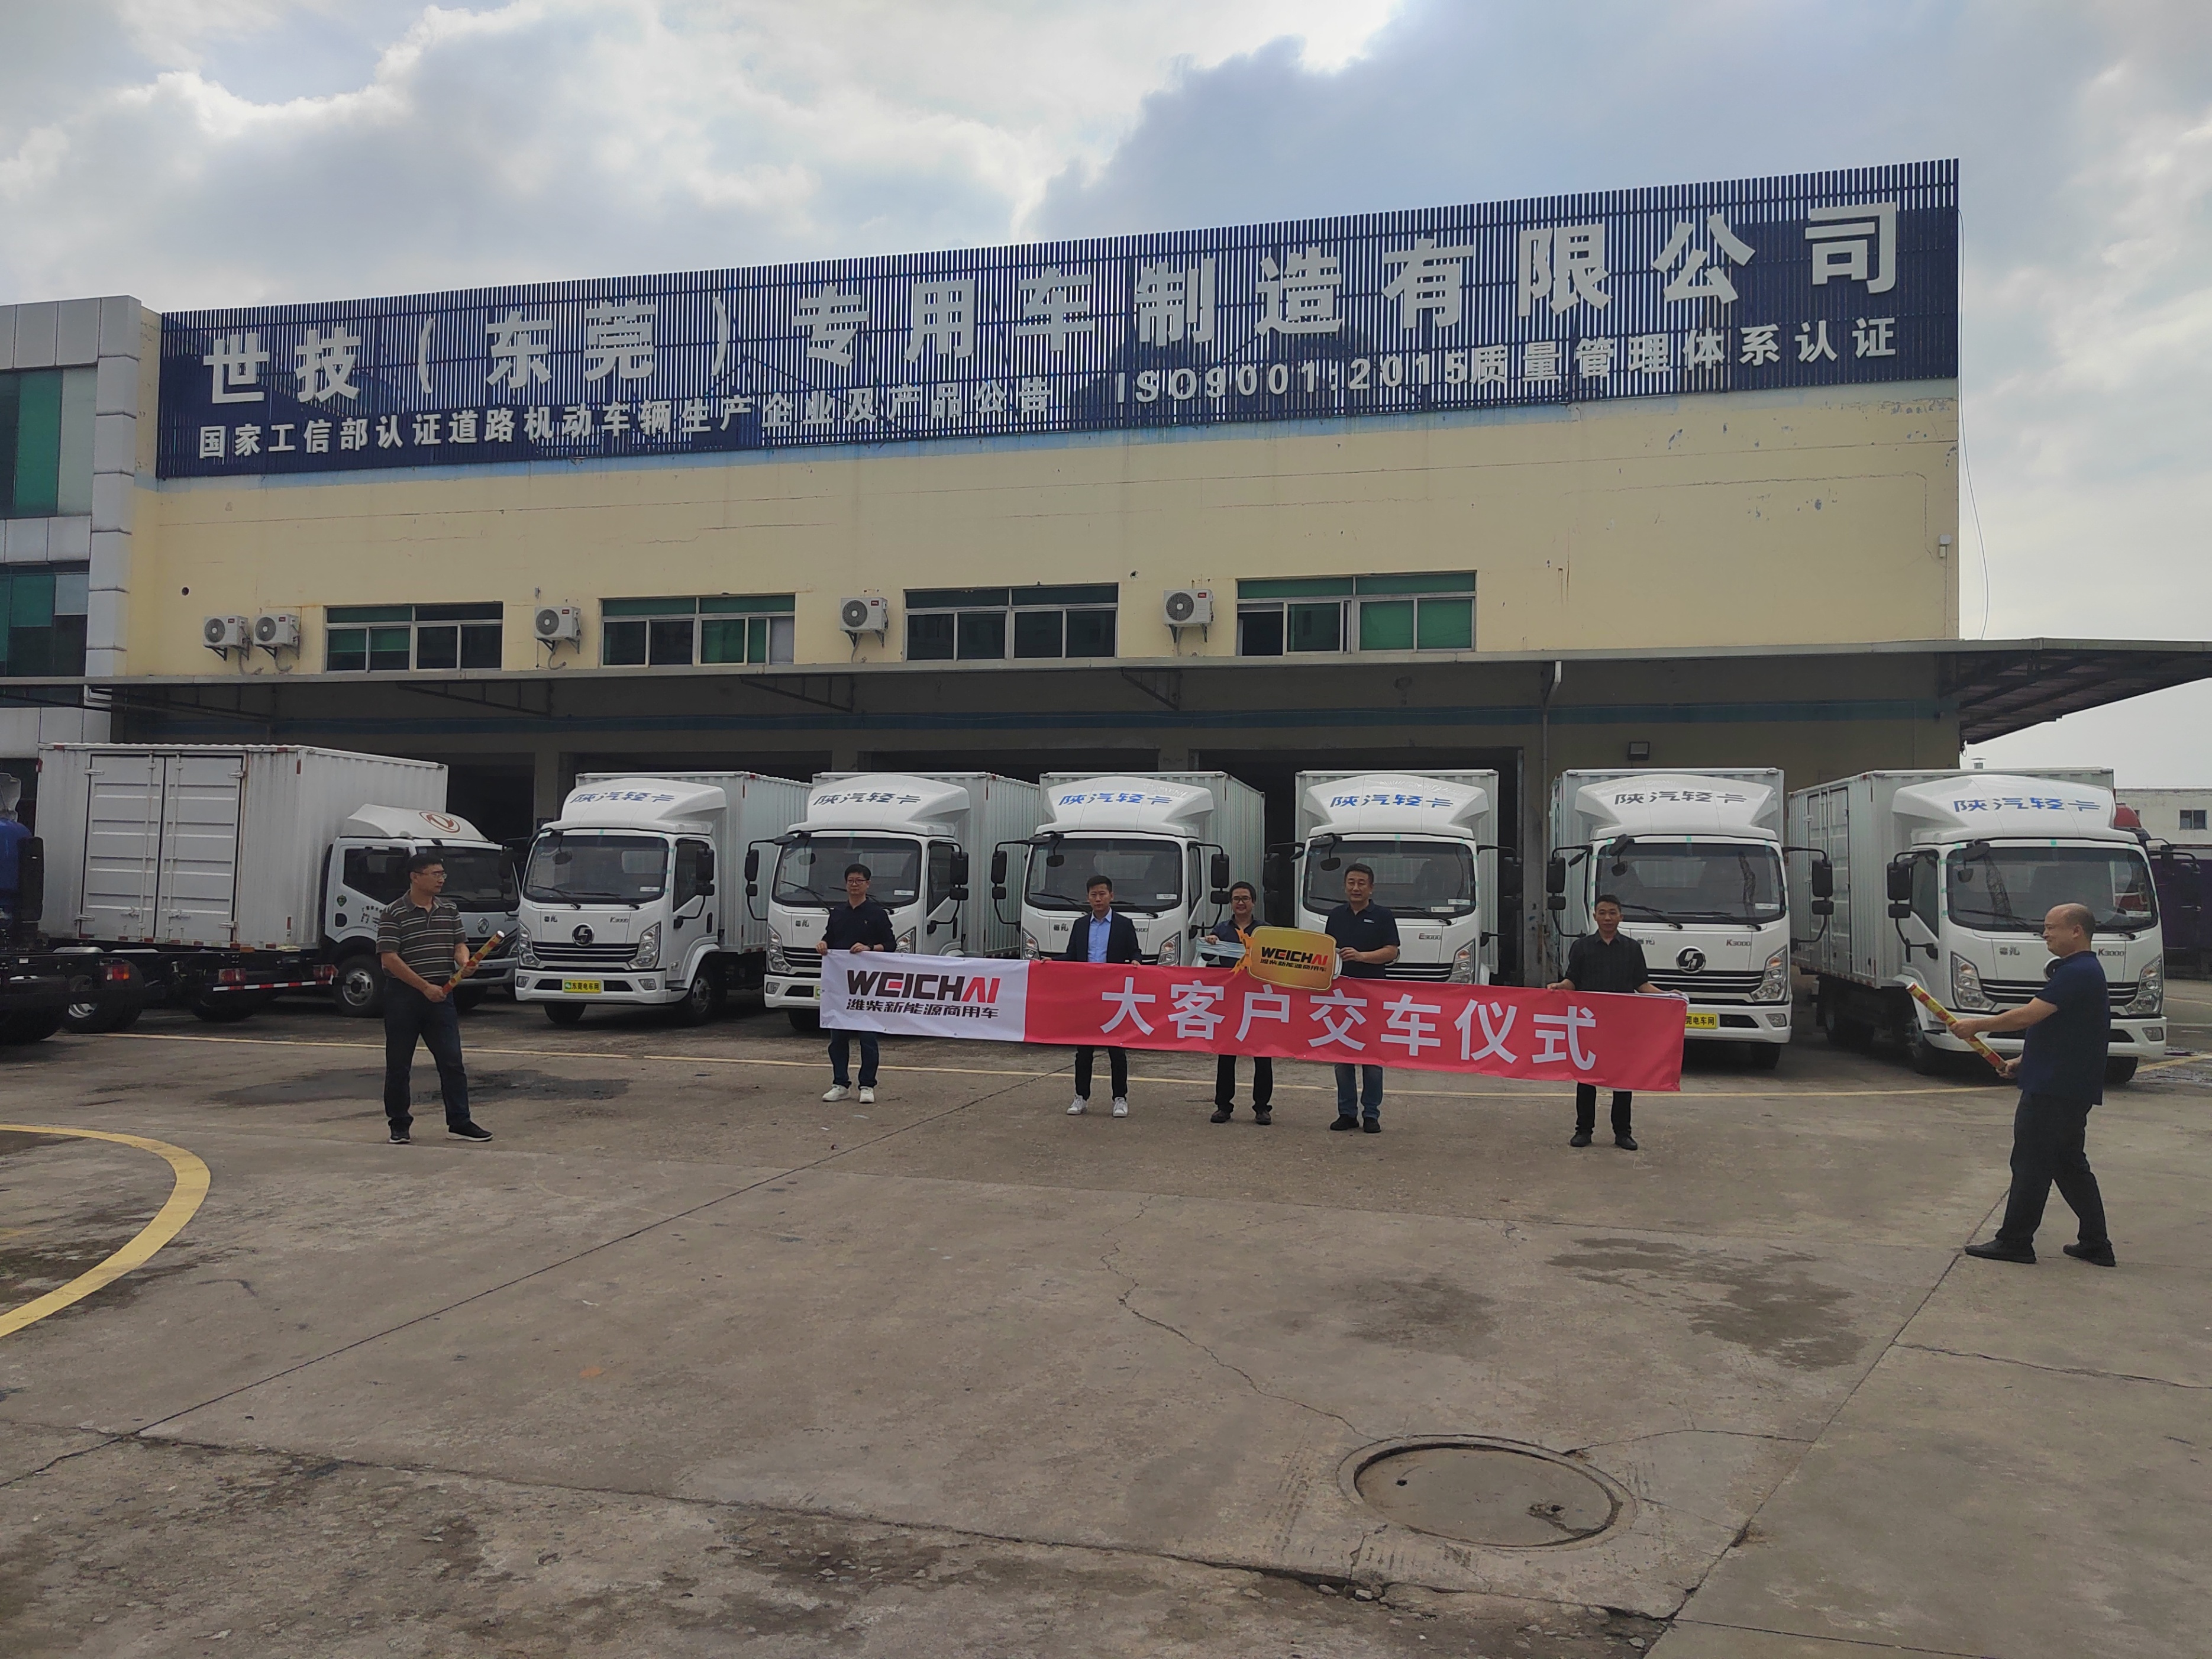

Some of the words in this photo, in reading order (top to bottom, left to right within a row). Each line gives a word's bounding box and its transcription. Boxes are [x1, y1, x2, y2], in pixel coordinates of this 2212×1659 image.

[203, 201, 1897, 405] 世技（东莞）专用车制造有限公司
[570, 792, 675, 803] 陕汽轻卡
[813, 792, 921, 805] 陕汽轻卡
[1058, 793, 1173, 805] 陕汽轻卡
[1330, 795, 1454, 808] 陕汽轻卡
[1614, 791, 1748, 805] 陕汽轻卡
[1953, 797, 2101, 812] 陕汽轻卡
[1261, 947, 1328, 966] WEICHAI
[571, 982, 599, 990] 东莞电车网
[847, 970, 1000, 1003] WEICHAI
[846, 998, 999, 1018] 潍柴新能源商用车
[1100, 976, 1596, 1070] 大客户交车仪式
[1685, 1015, 1714, 1025] 莞电车网
